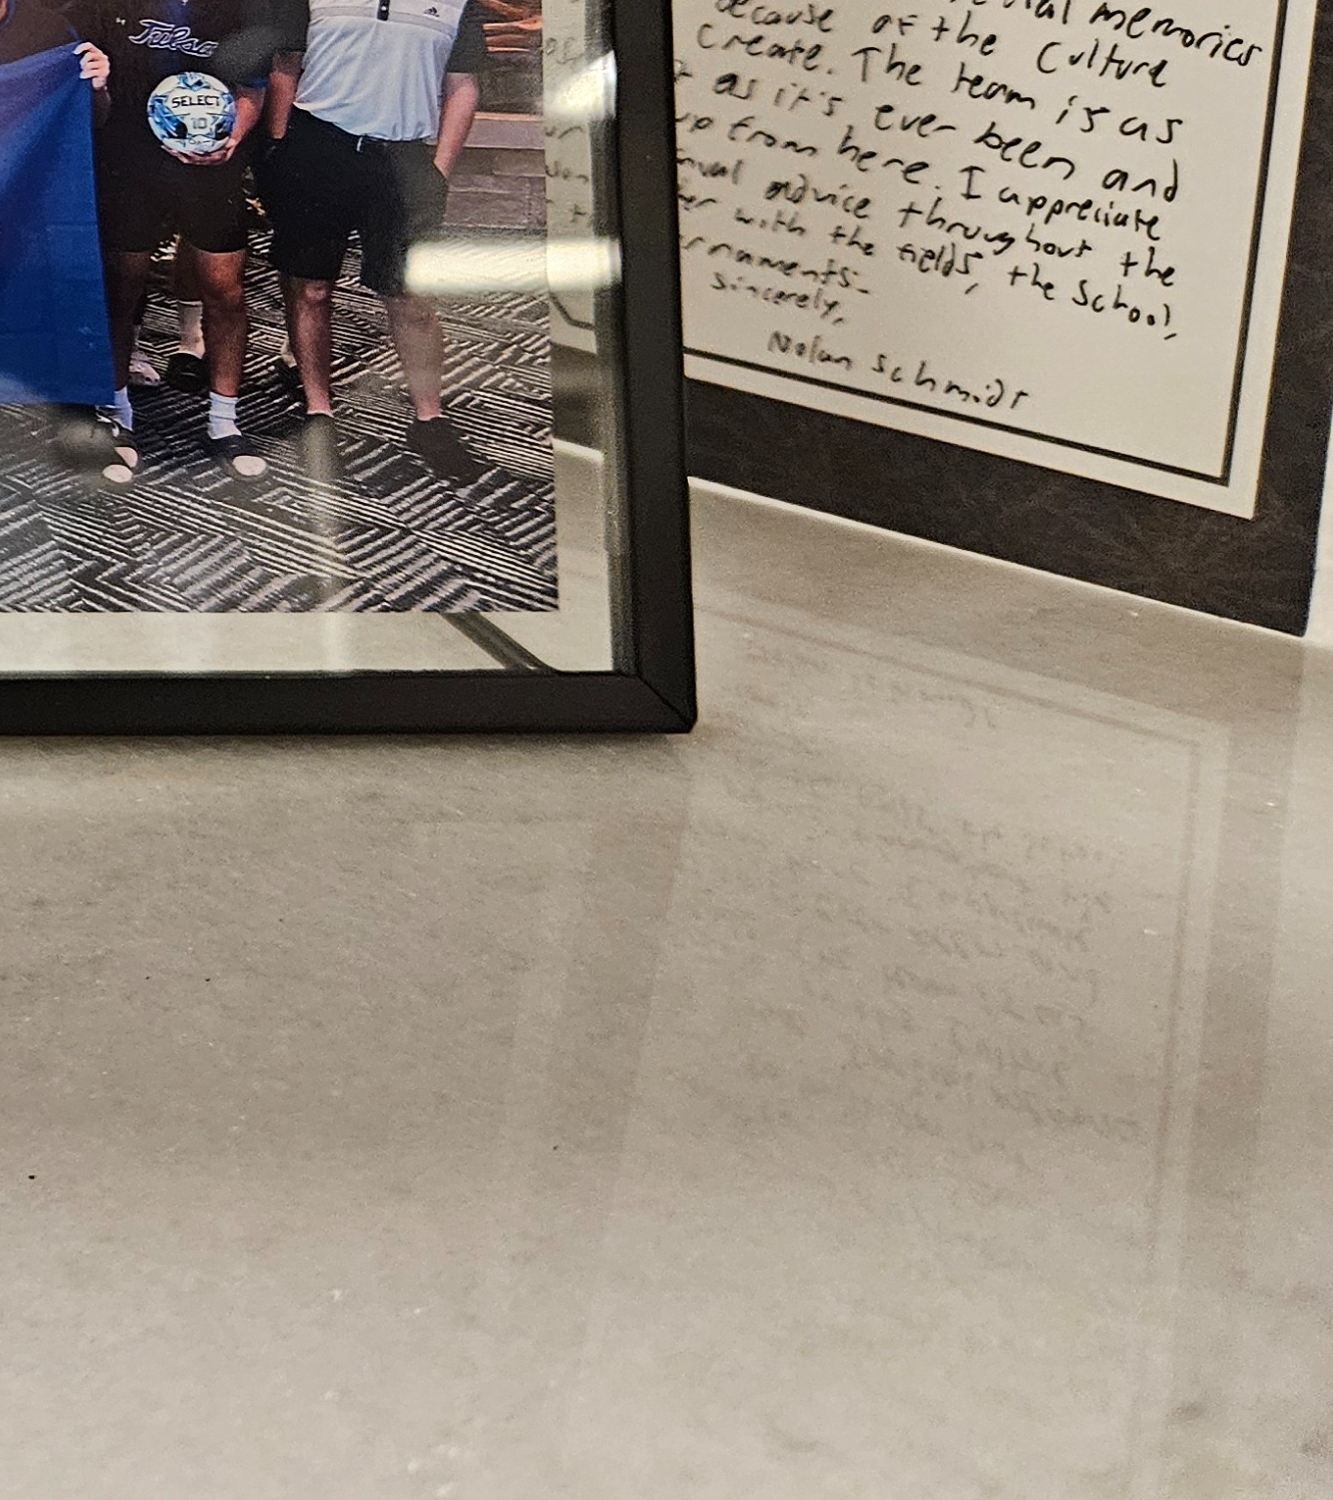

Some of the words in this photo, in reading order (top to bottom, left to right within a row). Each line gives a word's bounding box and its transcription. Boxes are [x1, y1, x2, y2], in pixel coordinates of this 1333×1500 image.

[129, 18, 219, 58] Tulsa
[931, 10, 998, 56] the
[1089, 2, 1263, 67] memories
[170, 95, 221, 110] SELECT
[713, 73, 757, 99] as
[774, 83, 842, 117] it's
[875, 103, 956, 138] ever
[974, 122, 1075, 179] been
[1101, 158, 1178, 203] and
[851, 42, 921, 85] The
[950, 62, 1035, 109] team
[1056, 96, 1111, 133] is
[1120, 117, 1183, 144] as
[727, 115, 817, 155] from
[837, 124, 942, 189] here.
[958, 165, 985, 199] I
[999, 186, 1161, 241] appreciate
[735, 208, 807, 236] with
[829, 225, 876, 256] the
[1008, 262, 1055, 301] the
[764, 173, 871, 219] advice
[899, 197, 1092, 258] throughout
[1119, 247, 1176, 287] the
